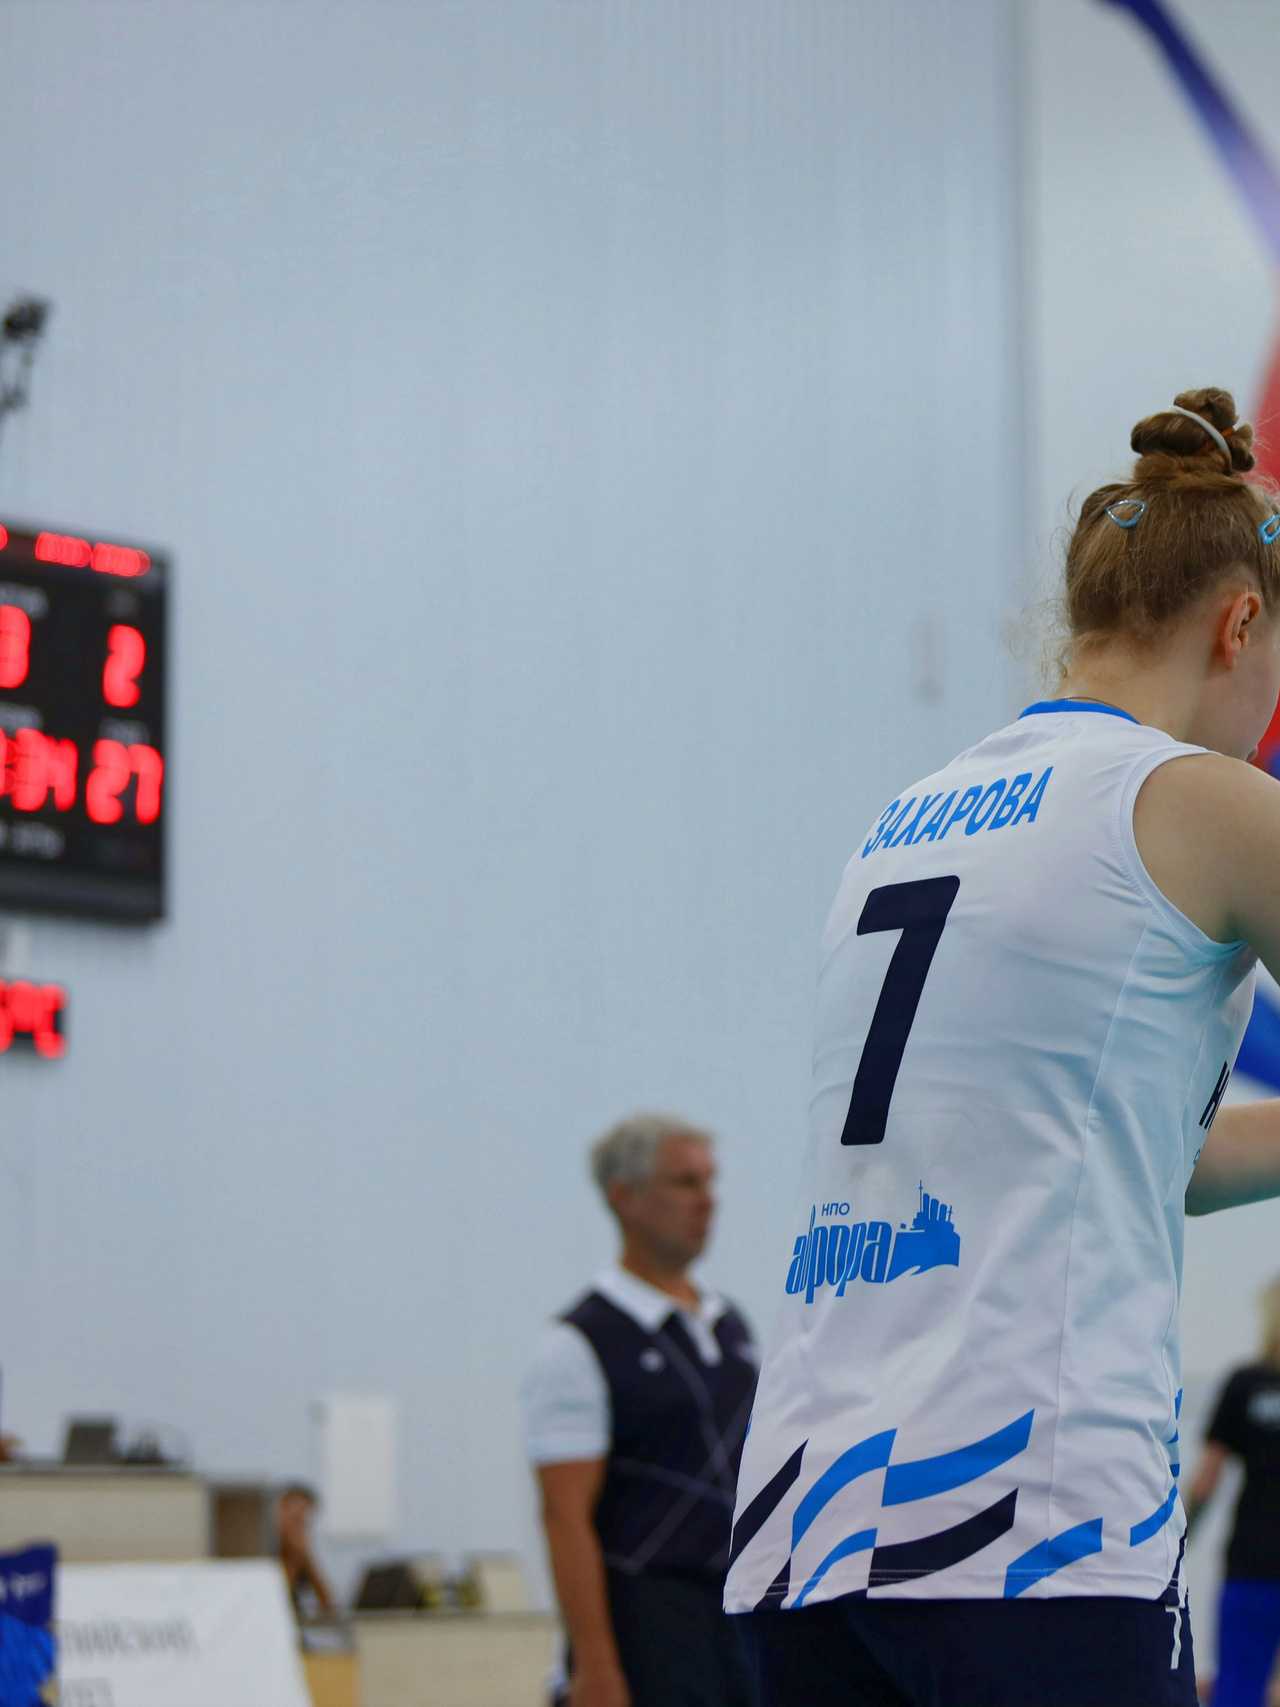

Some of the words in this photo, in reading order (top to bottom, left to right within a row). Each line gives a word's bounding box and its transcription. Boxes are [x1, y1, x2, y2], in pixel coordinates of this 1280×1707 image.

[103, 624, 146, 708] 2
[861, 766, 1054, 859] ЗАХАРОВА
[841, 875, 960, 1146] 7
[821, 1202, 850, 1217] НПО
